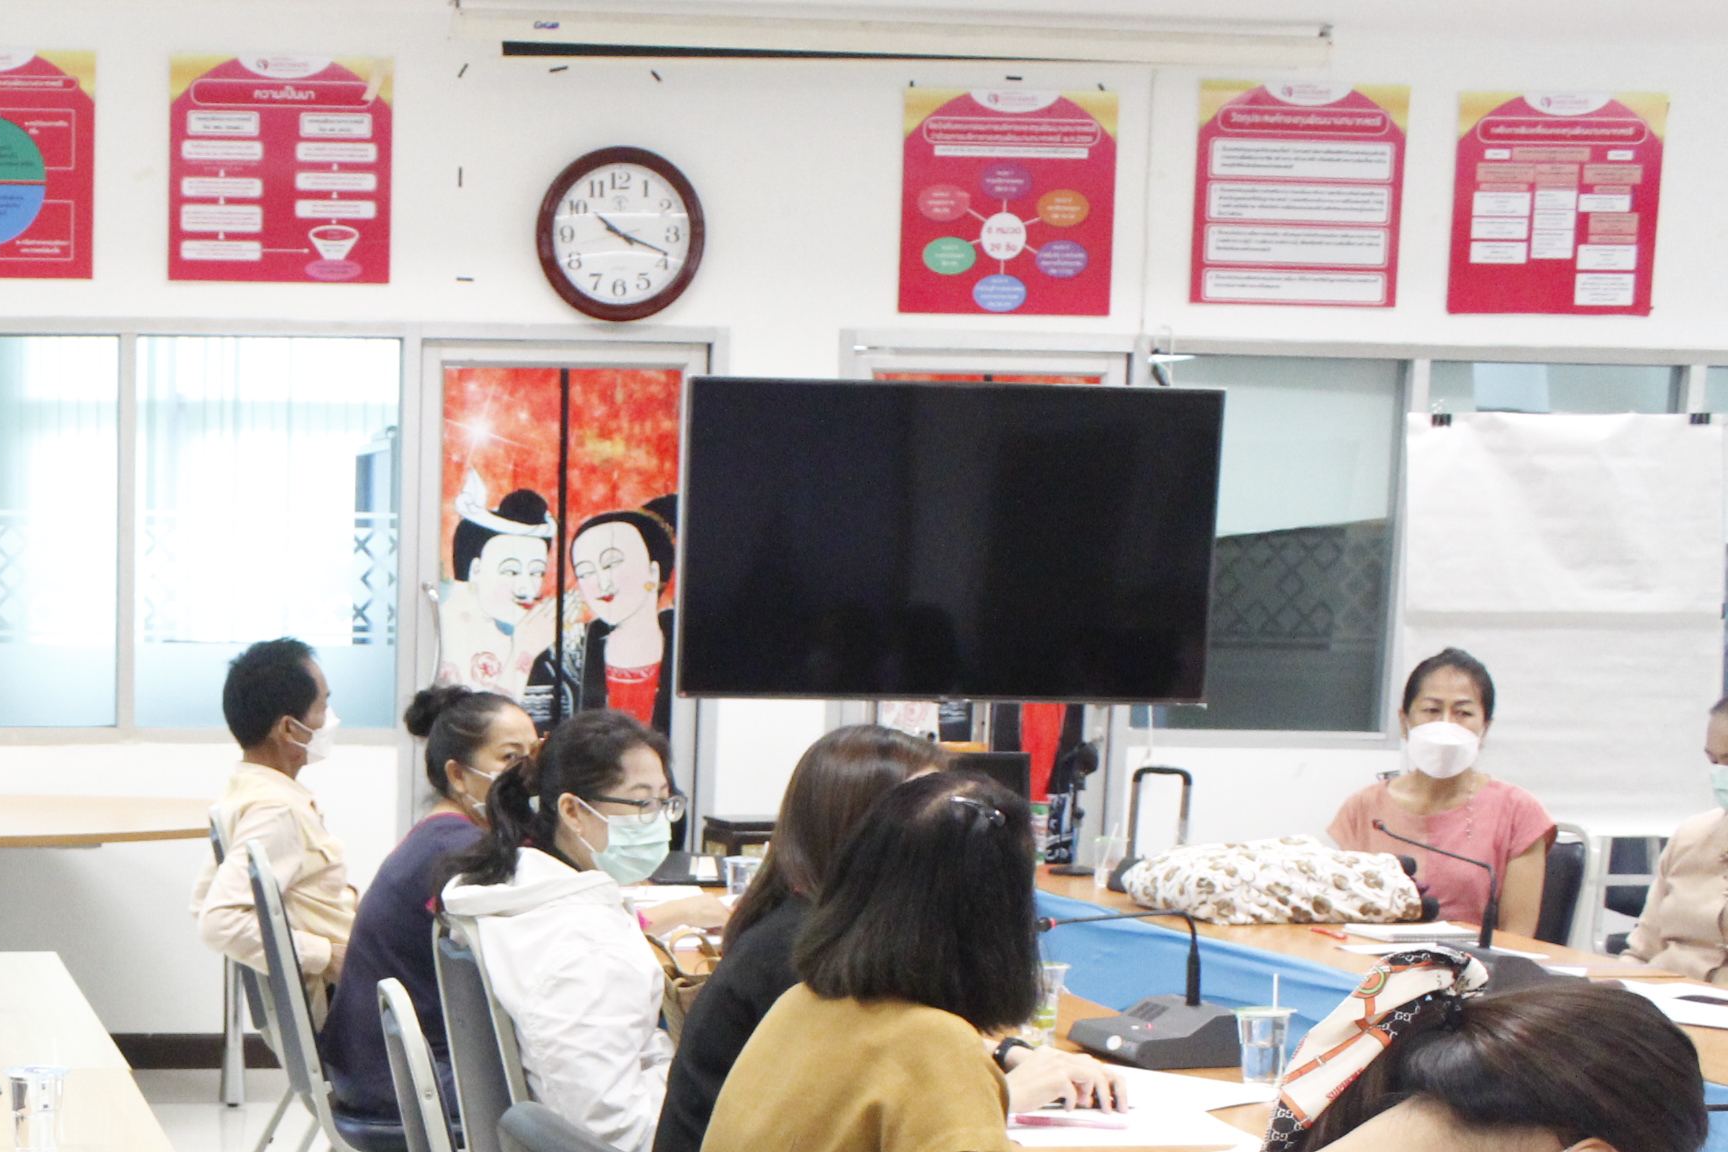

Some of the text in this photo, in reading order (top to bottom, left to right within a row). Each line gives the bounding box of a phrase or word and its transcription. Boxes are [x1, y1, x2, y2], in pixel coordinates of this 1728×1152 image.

[253, 85, 316, 100] ความเป็นมา
[589, 180, 604, 198] 11
[610, 171, 631, 190] 12
[642, 180, 650, 198] 1
[569, 199, 587, 216] 10
[659, 199, 672, 216] 2
[559, 225, 575, 243] 9
[665, 225, 680, 243] 3
[567, 252, 582, 270] 8
[655, 254, 669, 270] 4
[588, 273, 603, 291] 7
[612, 279, 626, 297] 6
[636, 272, 651, 291] 5
